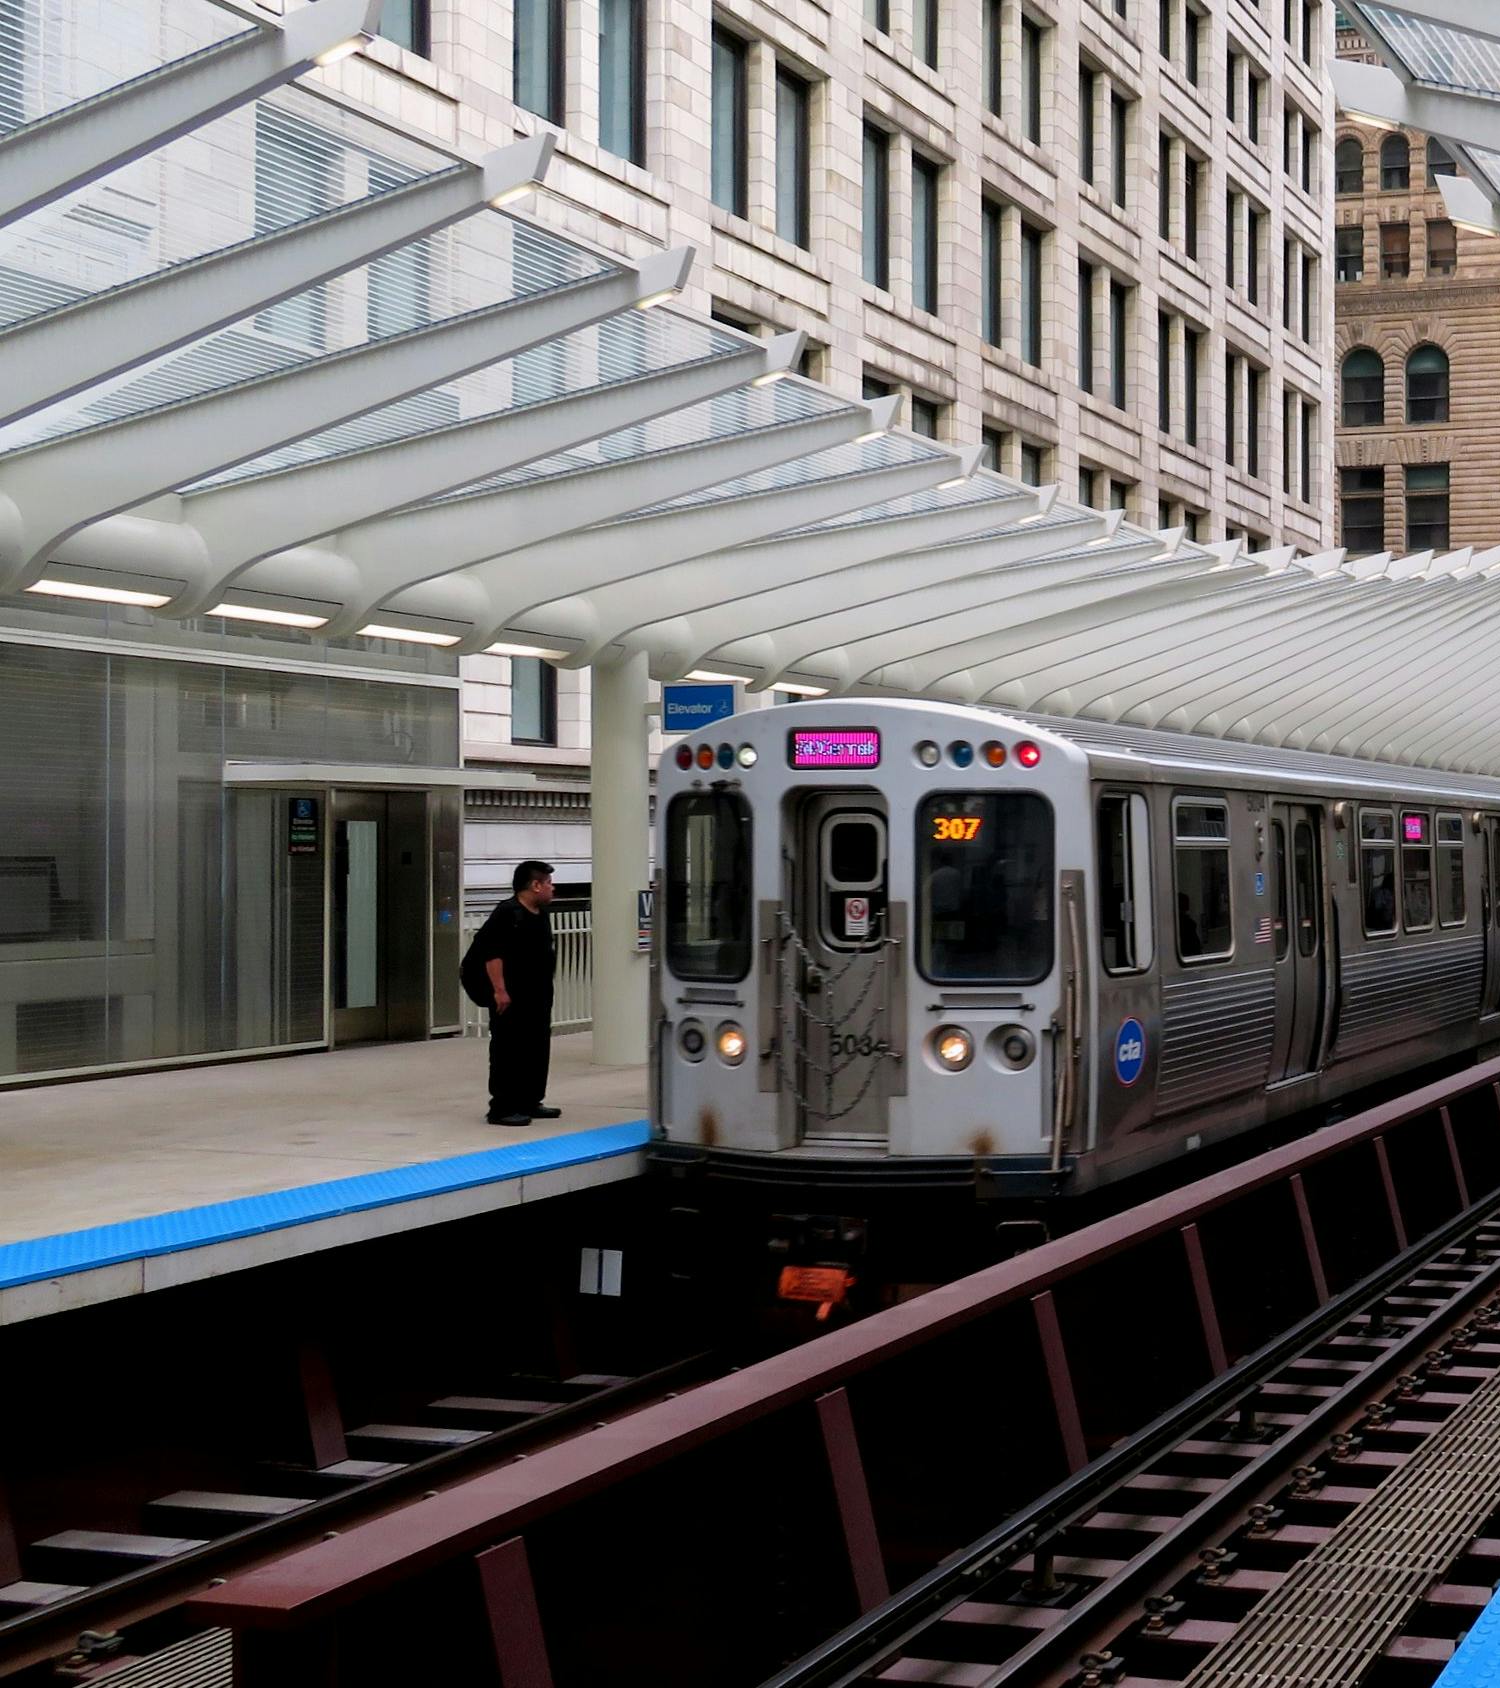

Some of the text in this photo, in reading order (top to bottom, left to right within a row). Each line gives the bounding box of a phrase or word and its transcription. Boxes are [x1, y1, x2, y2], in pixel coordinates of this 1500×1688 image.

[667, 703, 713, 714] Elevator
[932, 817, 981, 840] 307
[1119, 1038, 1141, 1063] cta
